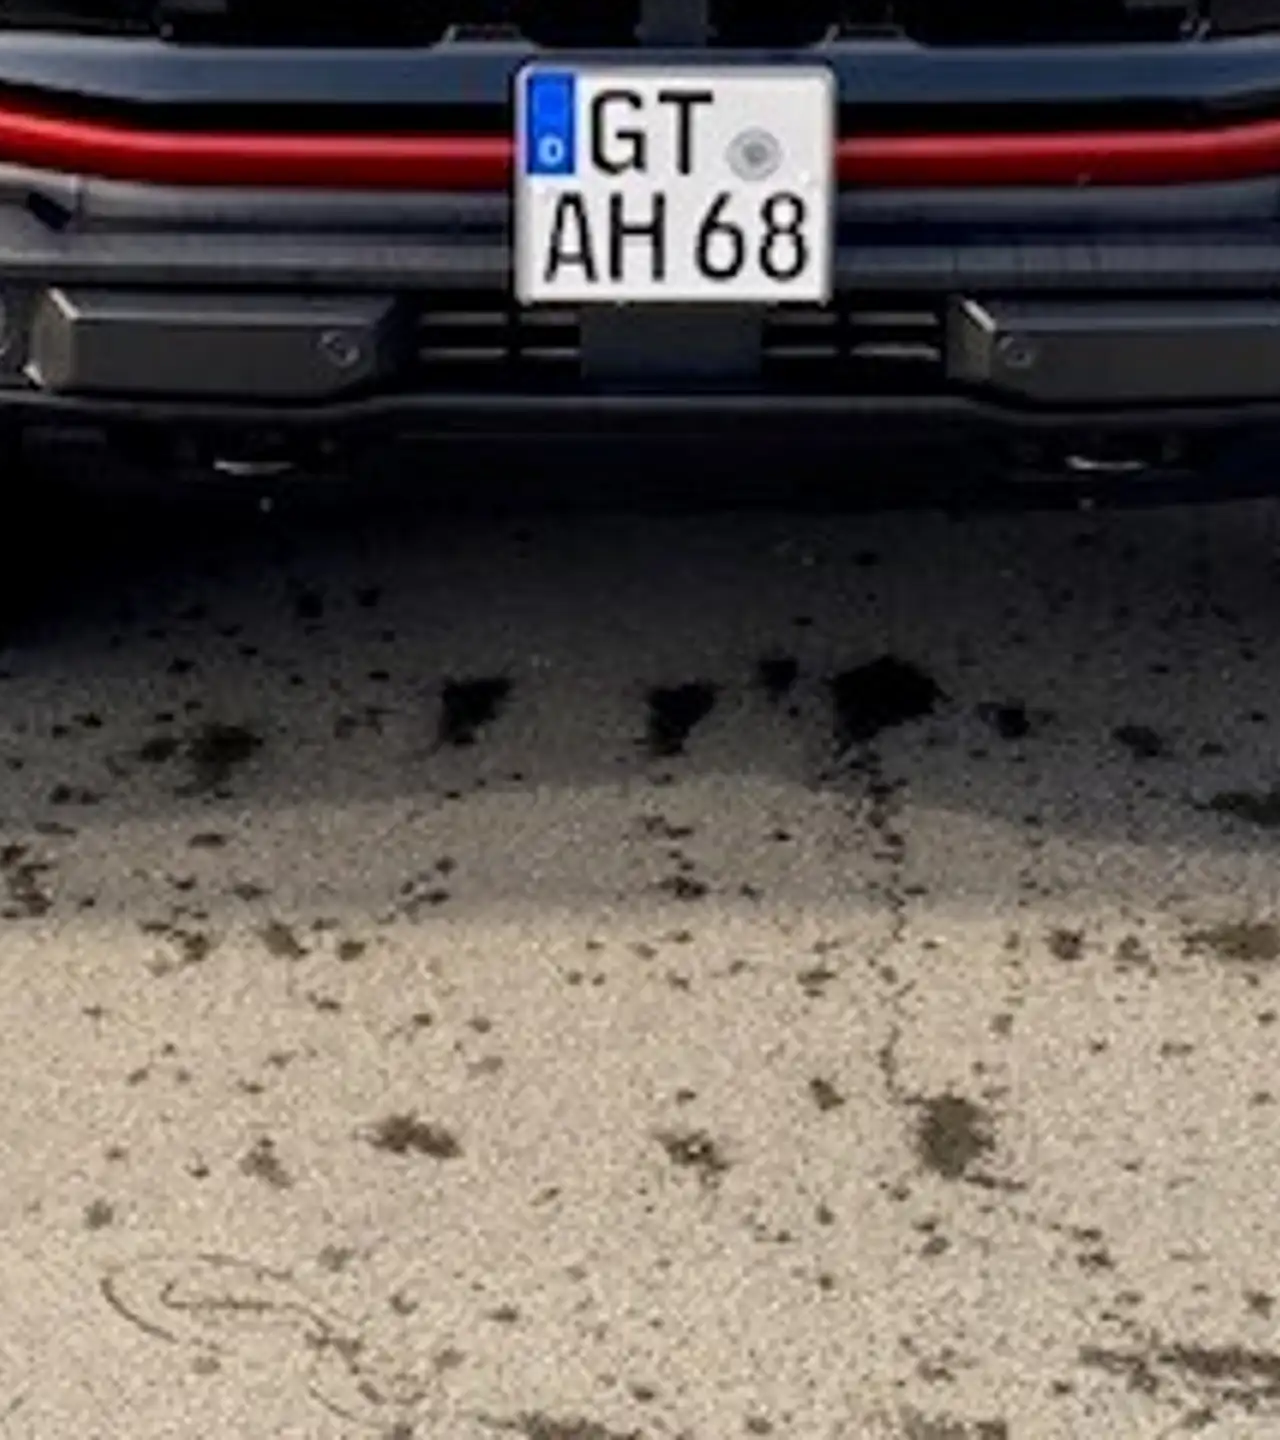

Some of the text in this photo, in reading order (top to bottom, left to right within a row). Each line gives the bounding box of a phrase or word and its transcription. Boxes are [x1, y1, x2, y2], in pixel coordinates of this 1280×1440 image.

[590, 89, 714, 176] GT
[543, 191, 808, 283] AH 68
